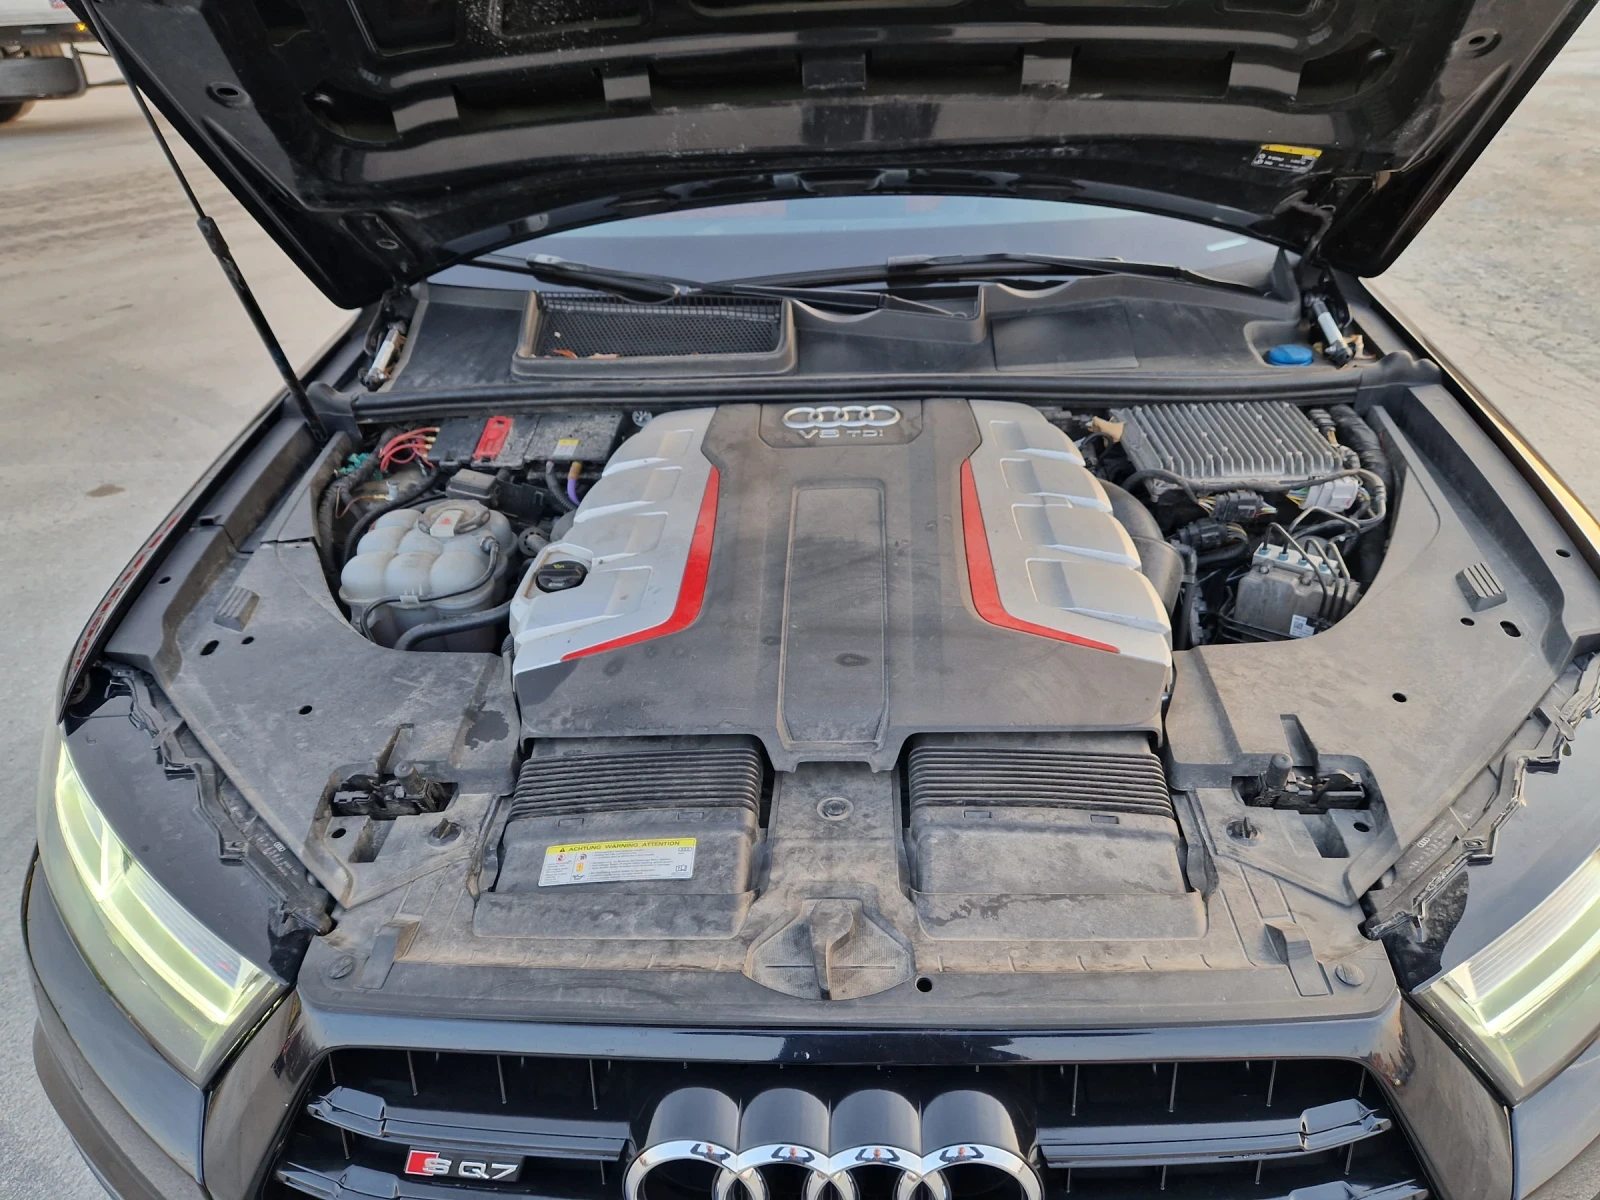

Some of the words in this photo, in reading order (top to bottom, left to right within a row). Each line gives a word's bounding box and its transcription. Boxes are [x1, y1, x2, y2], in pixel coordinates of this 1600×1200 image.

[846, 429, 884, 438] TDI
[568, 844, 601, 852] ACHTUNG
[641, 840, 680, 848] ATTENTION
